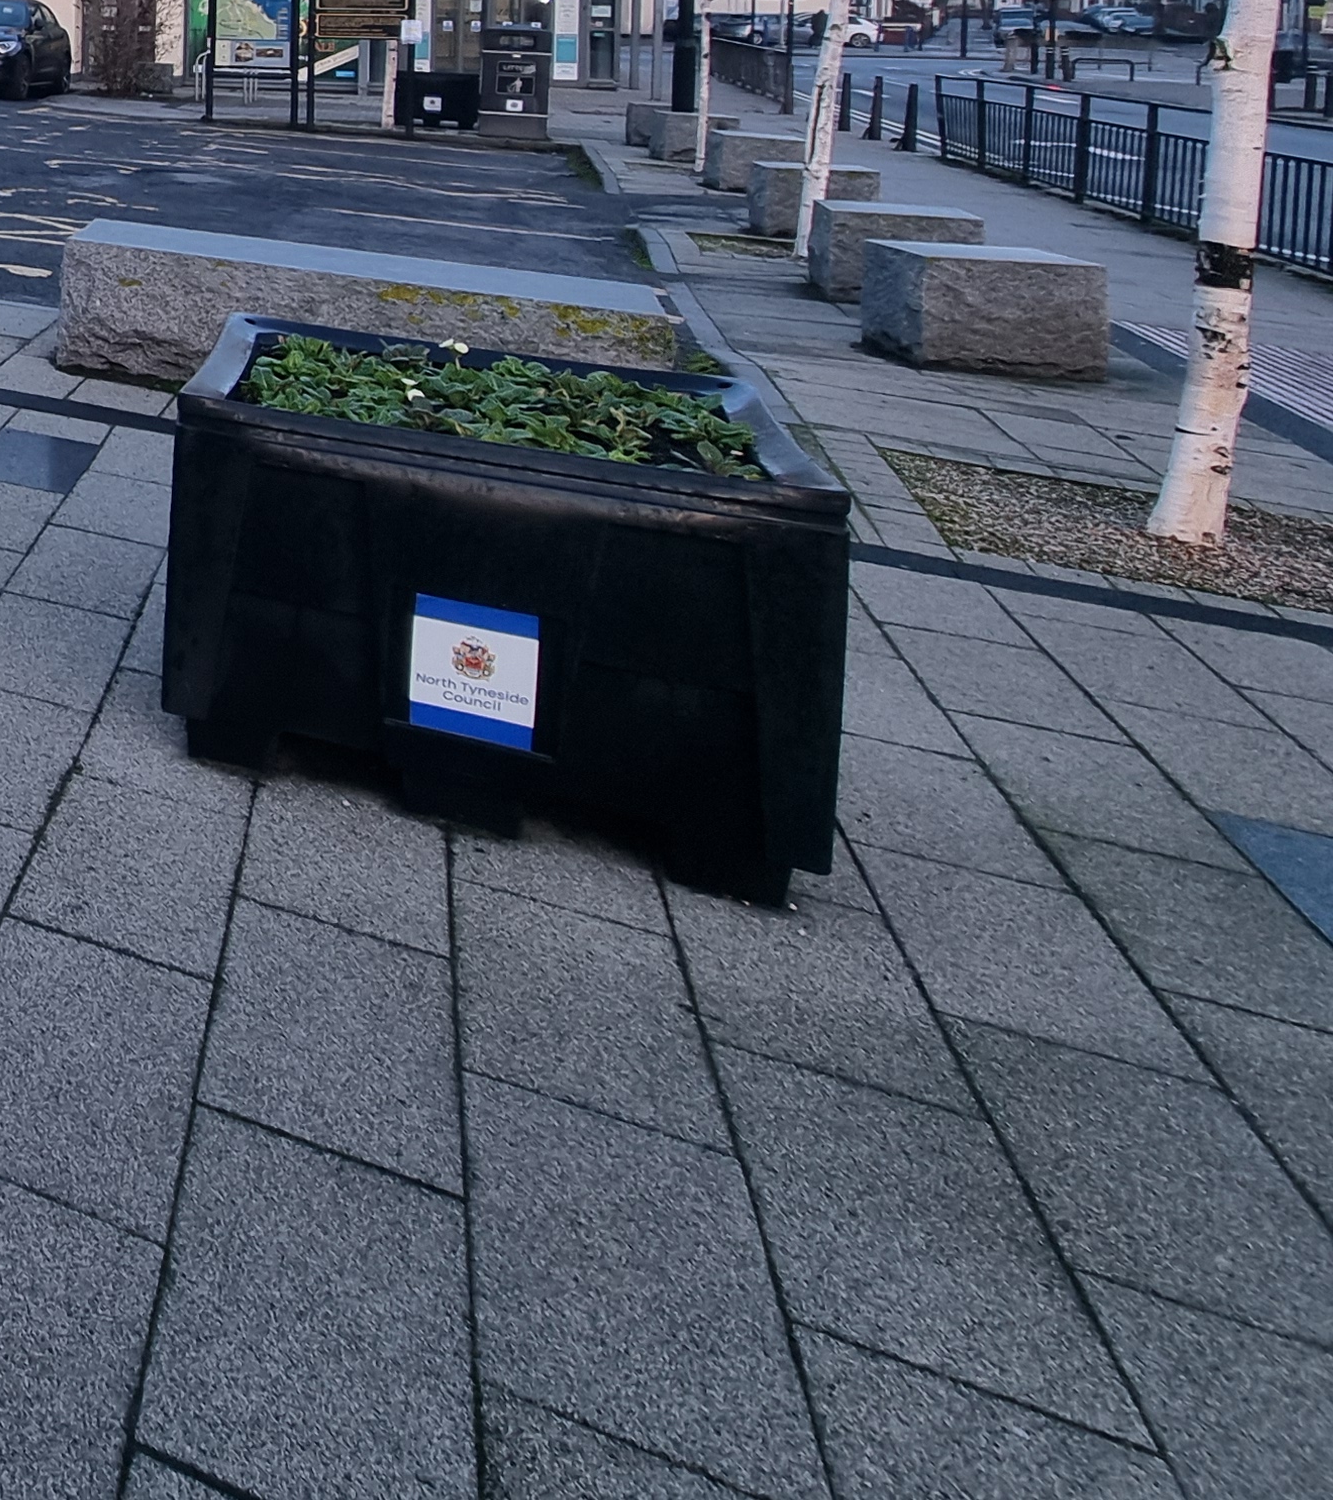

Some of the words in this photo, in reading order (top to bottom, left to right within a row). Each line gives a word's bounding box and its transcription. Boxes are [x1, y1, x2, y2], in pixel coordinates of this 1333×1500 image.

[415, 671, 458, 691] North
[460, 681, 530, 706] Tyneside
[442, 690, 503, 712] Council
